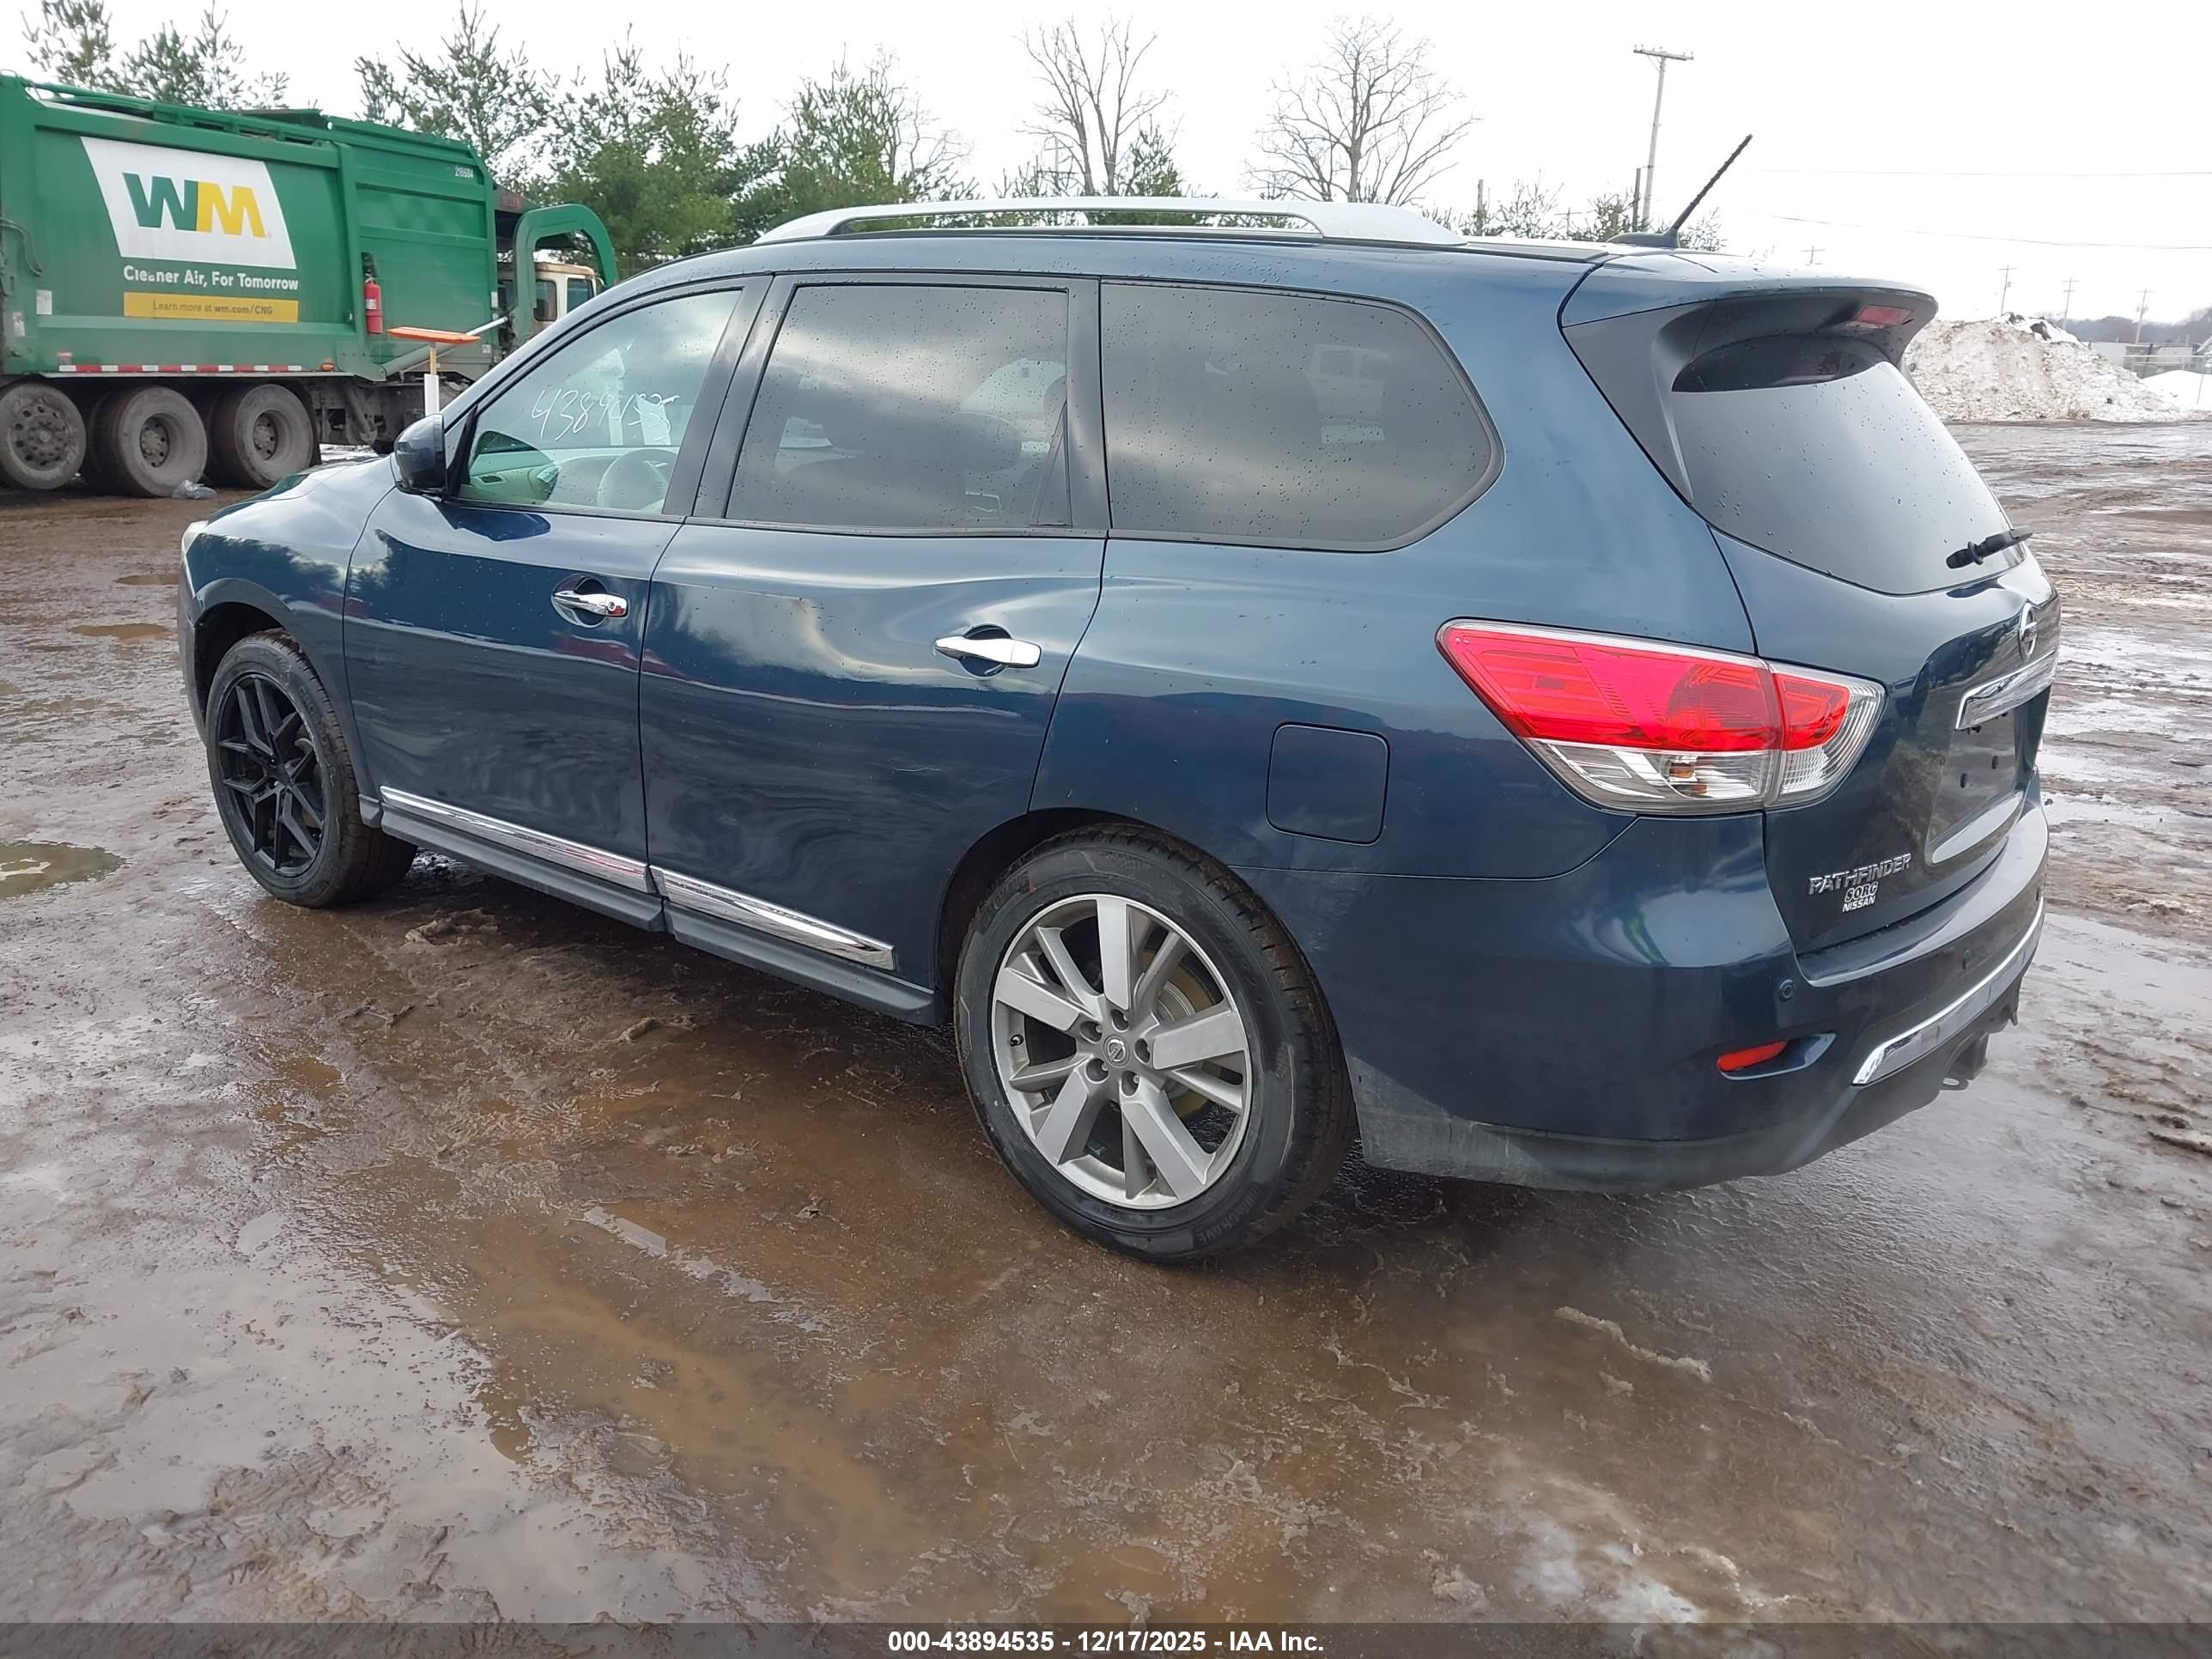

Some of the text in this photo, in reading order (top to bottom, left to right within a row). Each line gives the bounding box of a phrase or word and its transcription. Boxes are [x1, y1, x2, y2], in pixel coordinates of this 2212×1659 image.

[122, 172, 267, 239] WM
[124, 264, 298, 290] Cleaner Air, For Tomorrow
[153, 301, 178, 311] Learn
[179, 303, 202, 312] more
[214, 304, 273, 315] wm.com/CNG
[1808, 853, 1911, 895] PATHFINDER
[1842, 895, 1876, 912] NISSAN
